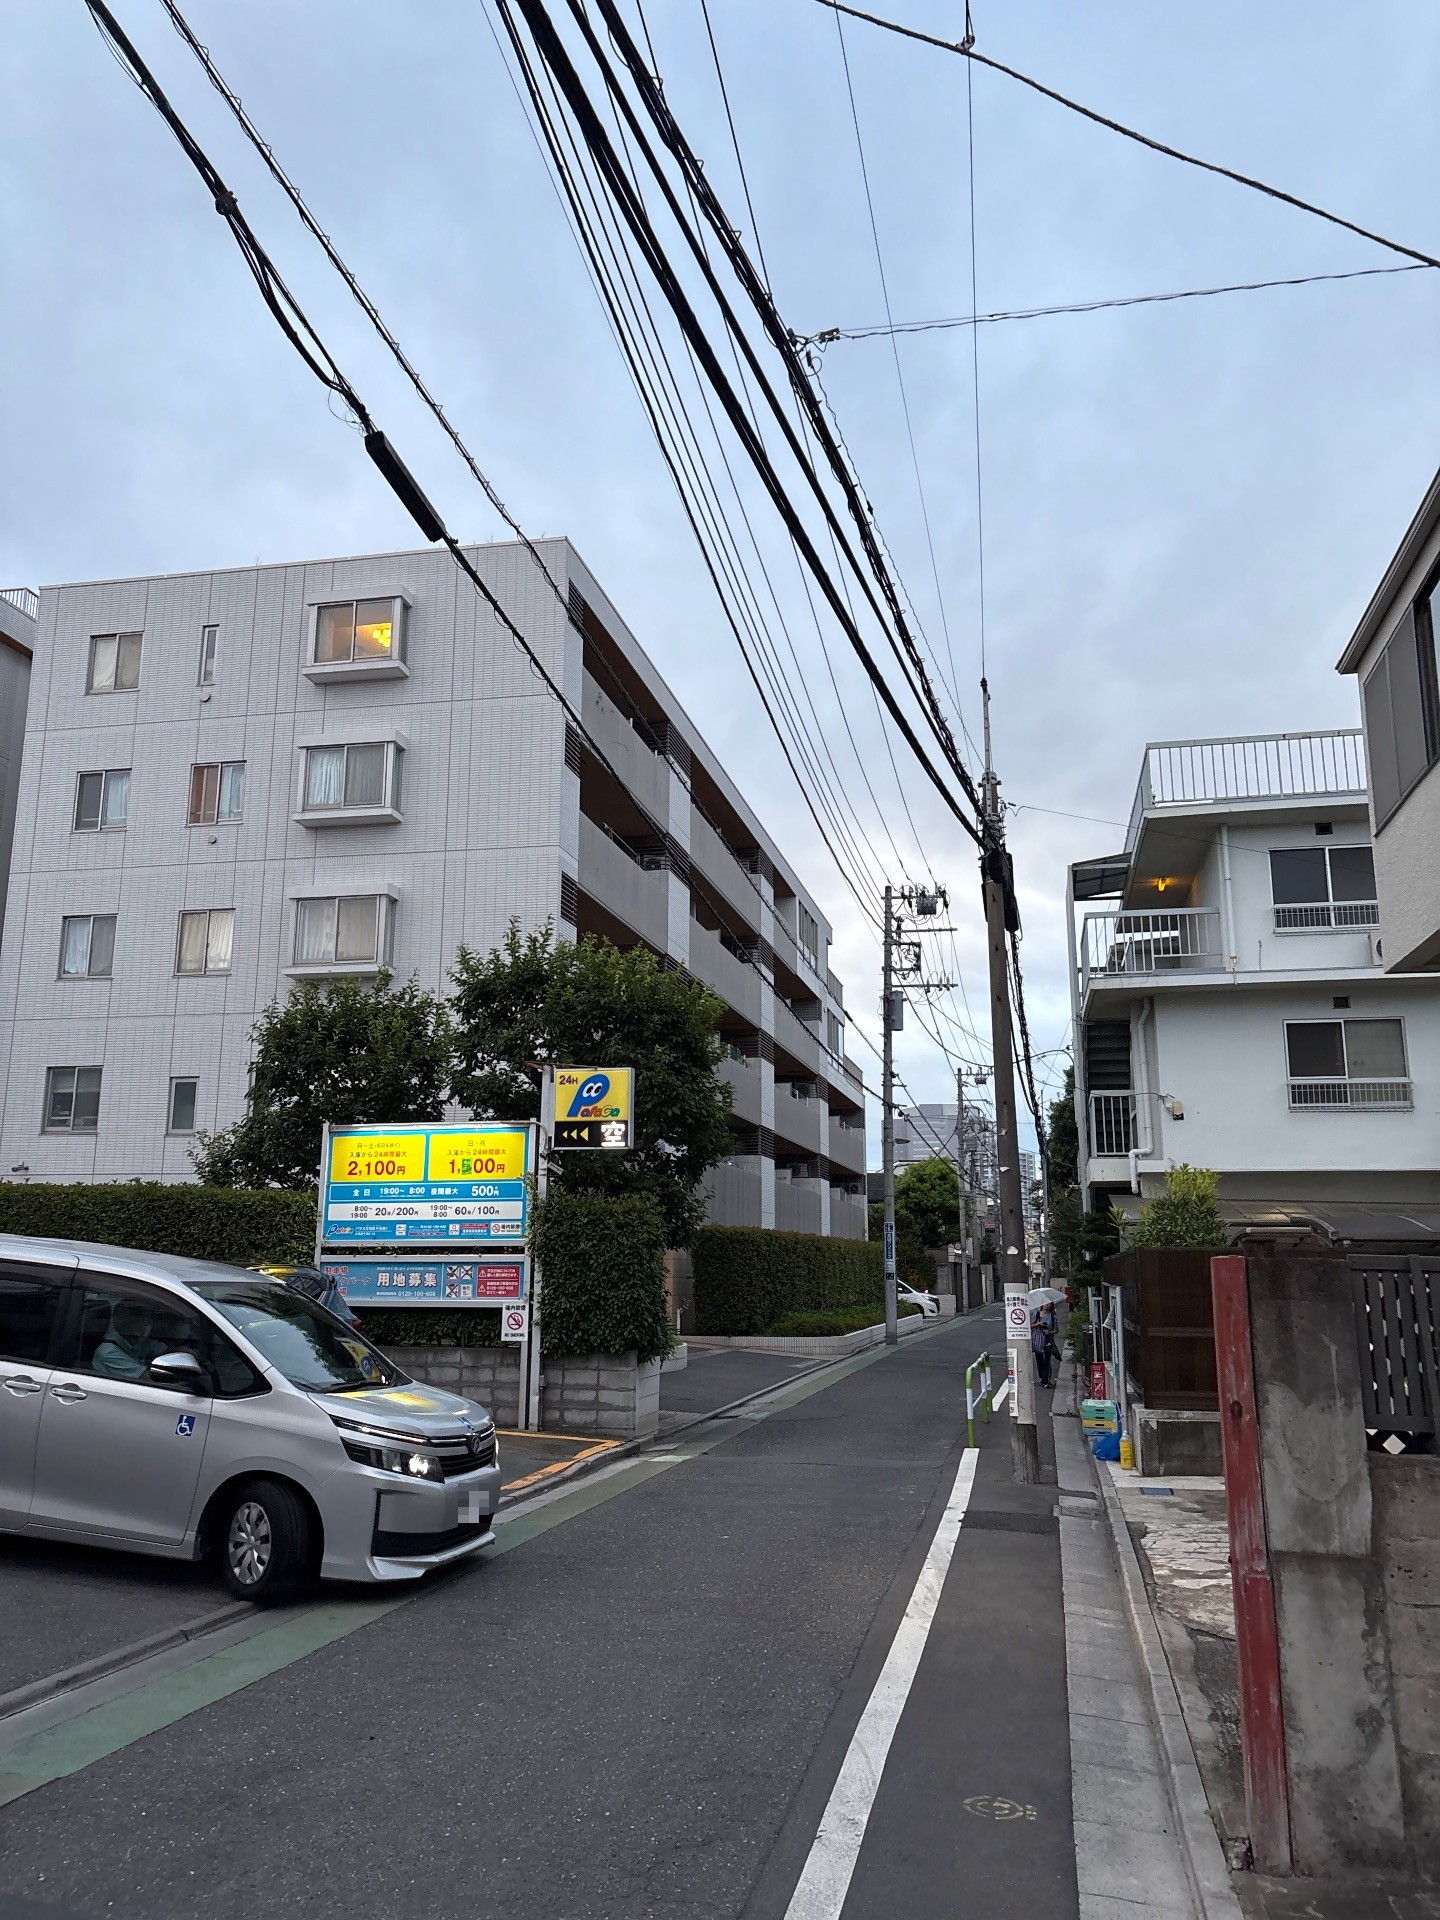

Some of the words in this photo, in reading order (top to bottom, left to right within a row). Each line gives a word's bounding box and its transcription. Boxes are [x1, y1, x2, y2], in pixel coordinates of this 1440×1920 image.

[559, 1075, 578, 1085] 24H
[601, 1121, 626, 1147] 空
[347, 1160, 406, 1176] 2,100円
[430, 1187, 459, 1195] 夜間最大
[376, 1272, 437, 1287] 用地募集
